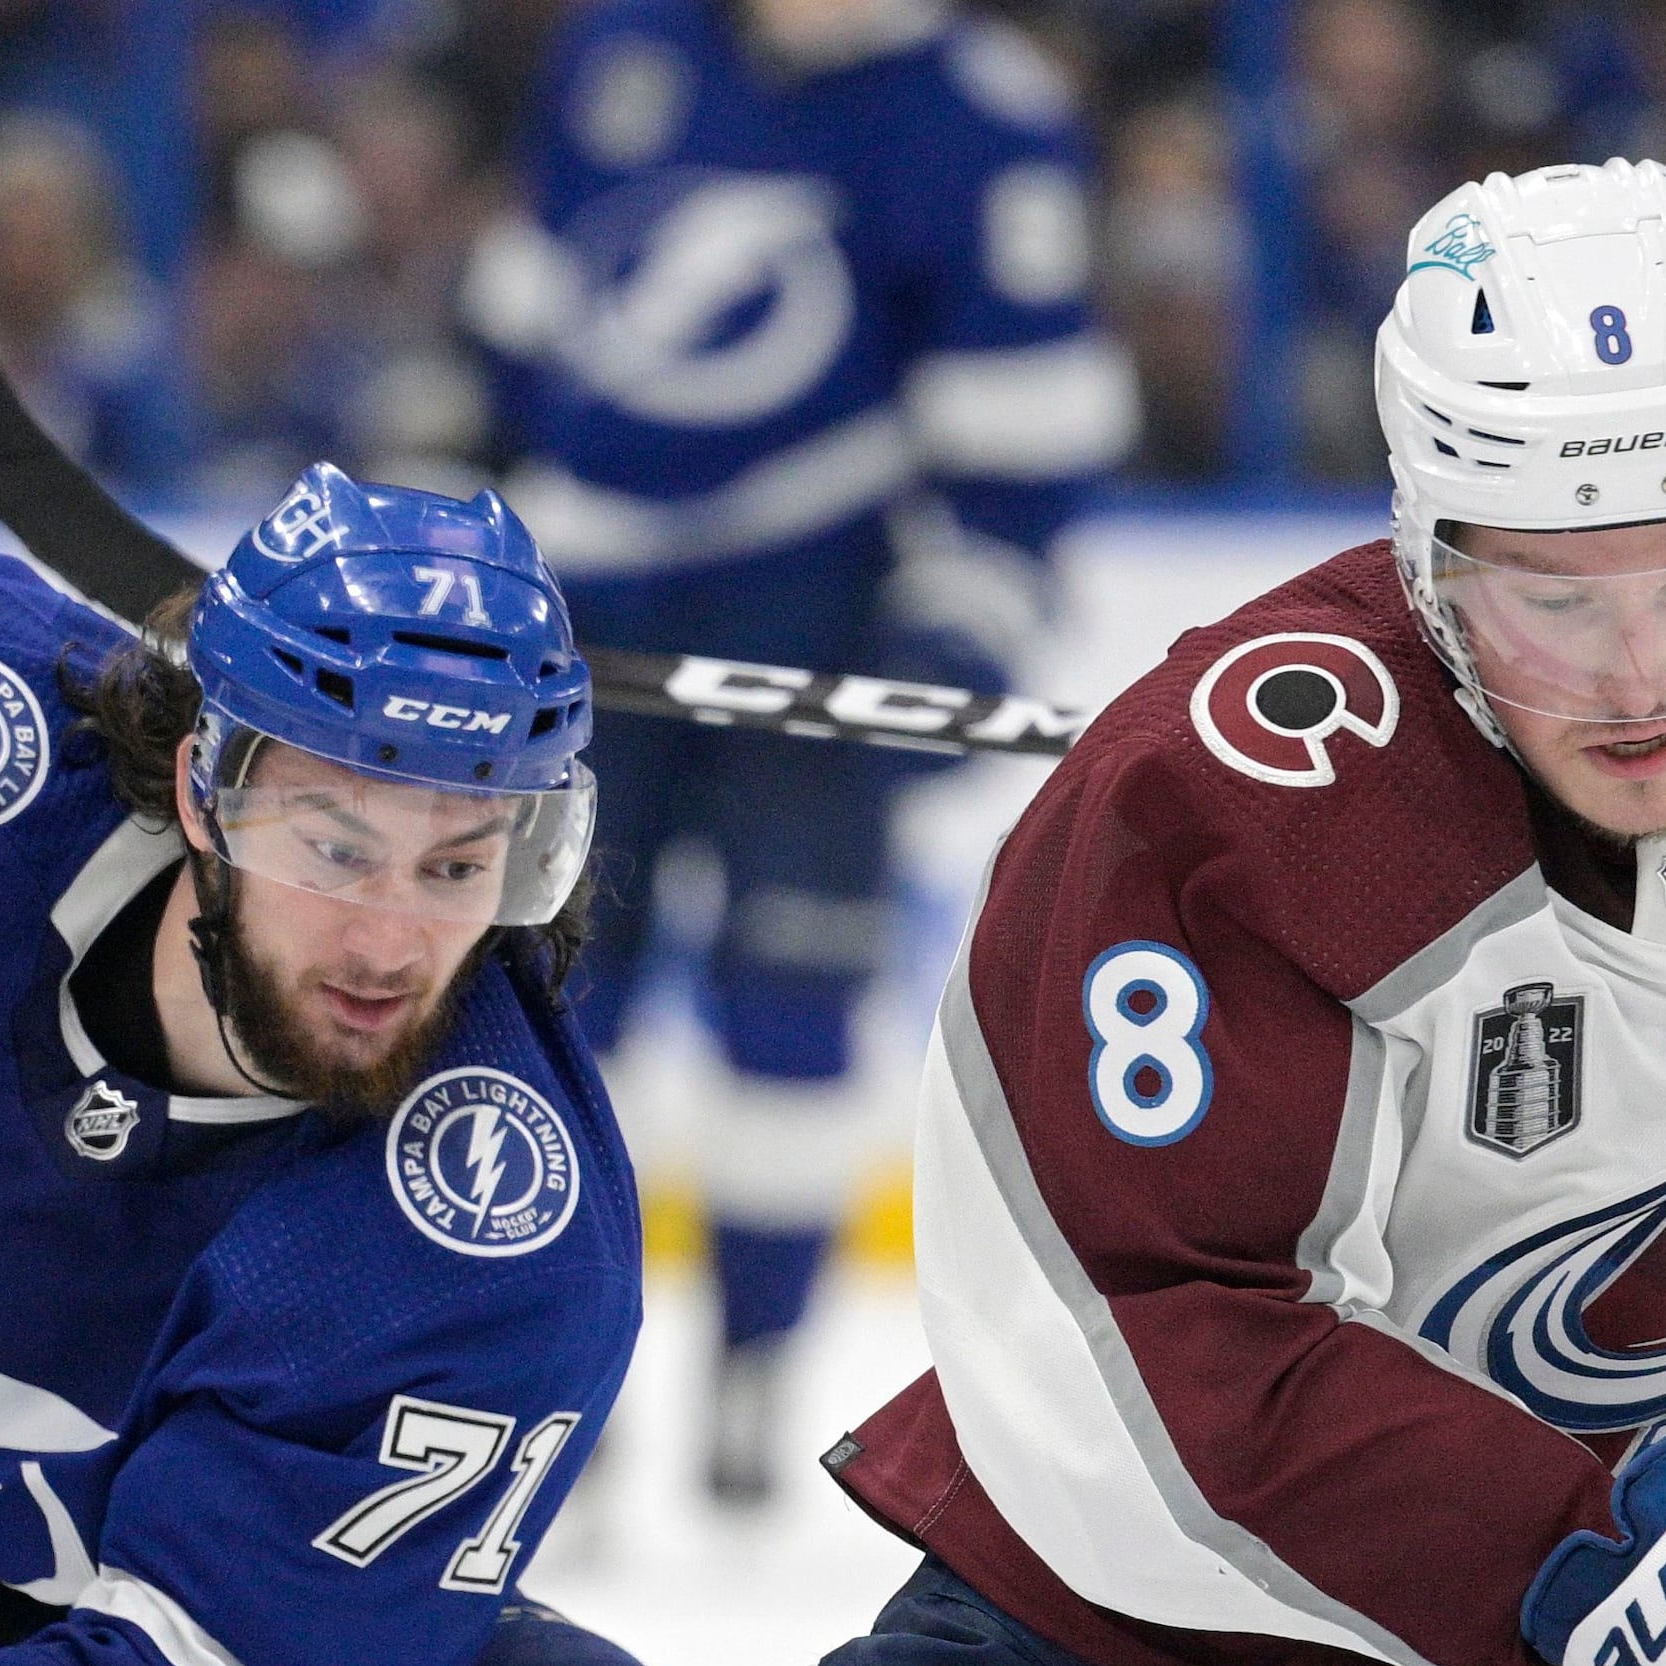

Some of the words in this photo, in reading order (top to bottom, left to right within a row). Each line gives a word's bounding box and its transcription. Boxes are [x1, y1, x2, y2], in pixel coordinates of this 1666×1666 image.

[1589, 305, 1632, 364] 8
[412, 565, 492, 628] 71
[383, 695, 512, 735] CCM
[13, 725, 37, 777] BAY
[1083, 939, 1214, 1147] 8
[1482, 1036, 1505, 1054] 20
[1548, 1026, 1573, 1043] 22
[410, 1087, 452, 1134] BAY
[461, 1080, 567, 1192] LIGHTNING
[404, 1140, 456, 1230] TAMPA
[490, 1207, 538, 1231] HOCKEY
[506, 1223, 537, 1240] CLUB
[311, 1394, 582, 1595] 71
